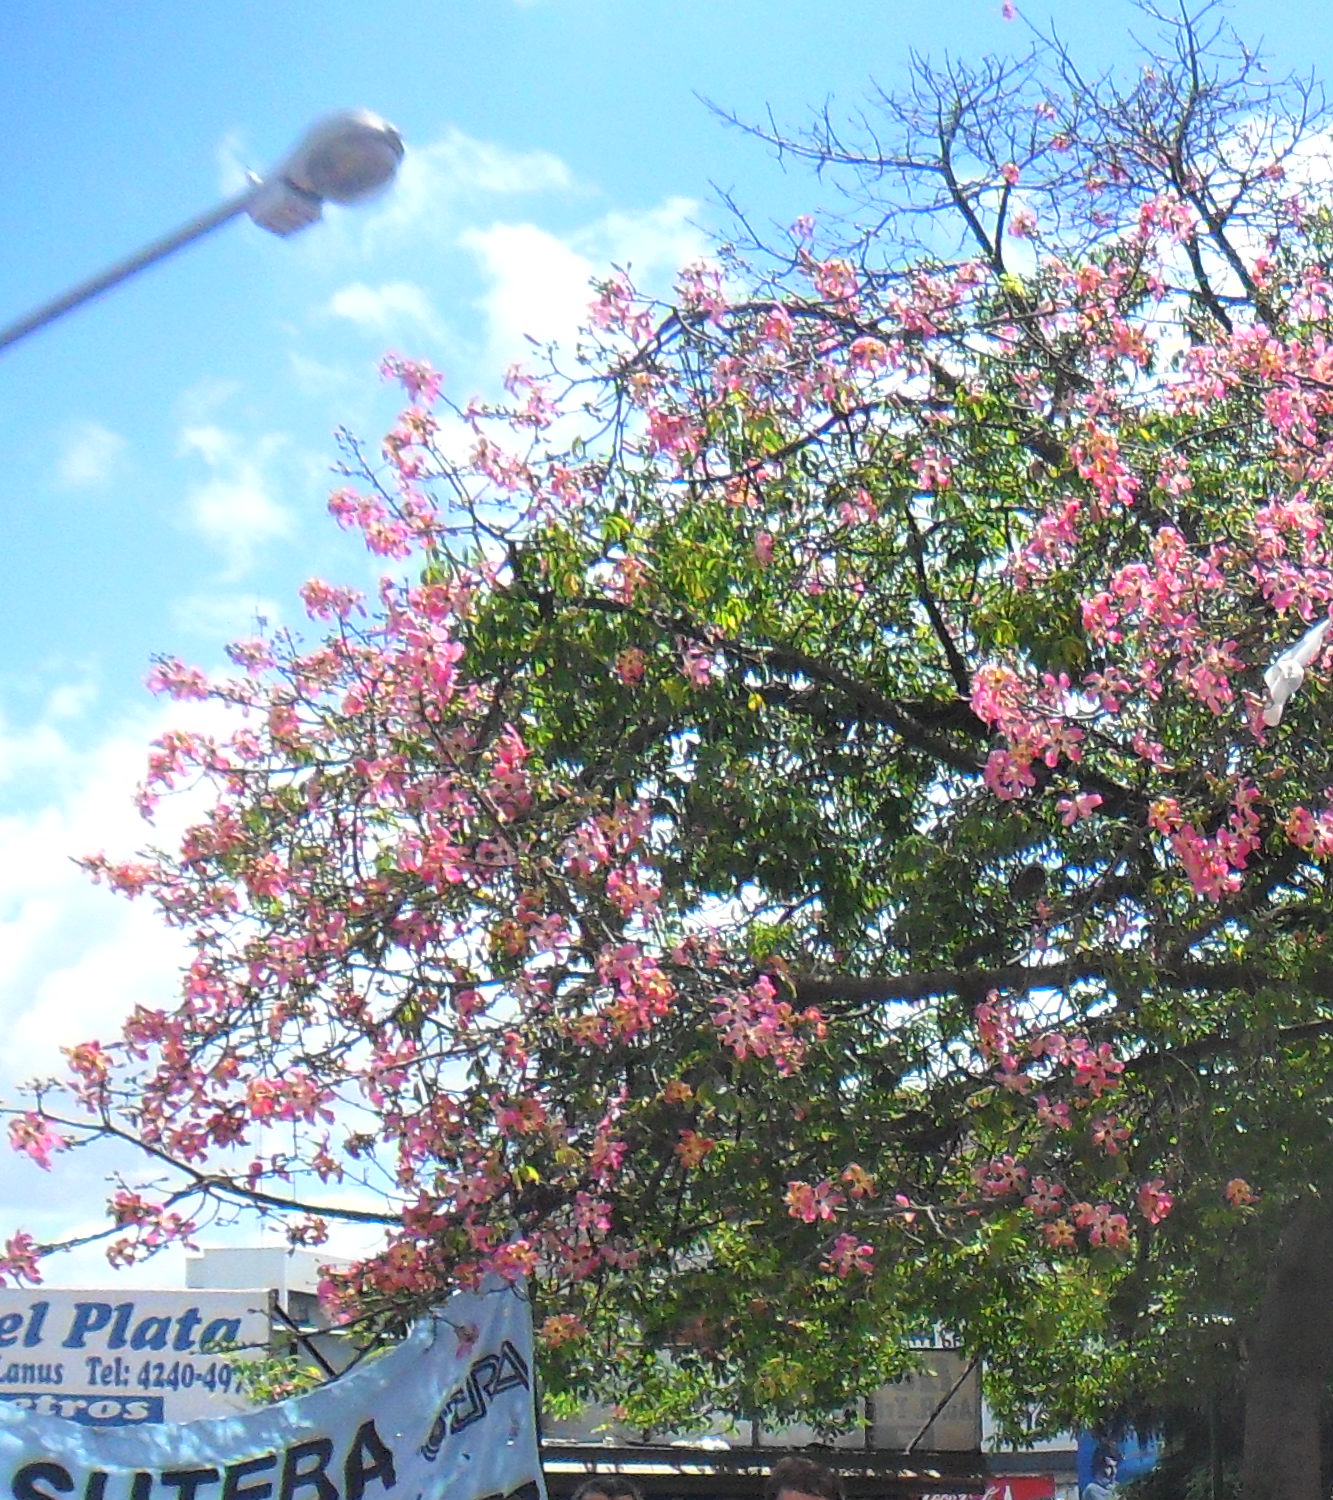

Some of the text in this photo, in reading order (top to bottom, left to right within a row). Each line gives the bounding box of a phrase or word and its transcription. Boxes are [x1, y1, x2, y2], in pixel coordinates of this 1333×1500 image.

[62, 1302, 242, 1354] Plata
[0, 1362, 64, 1386] anus
[86, 1356, 130, 1388] Tel:
